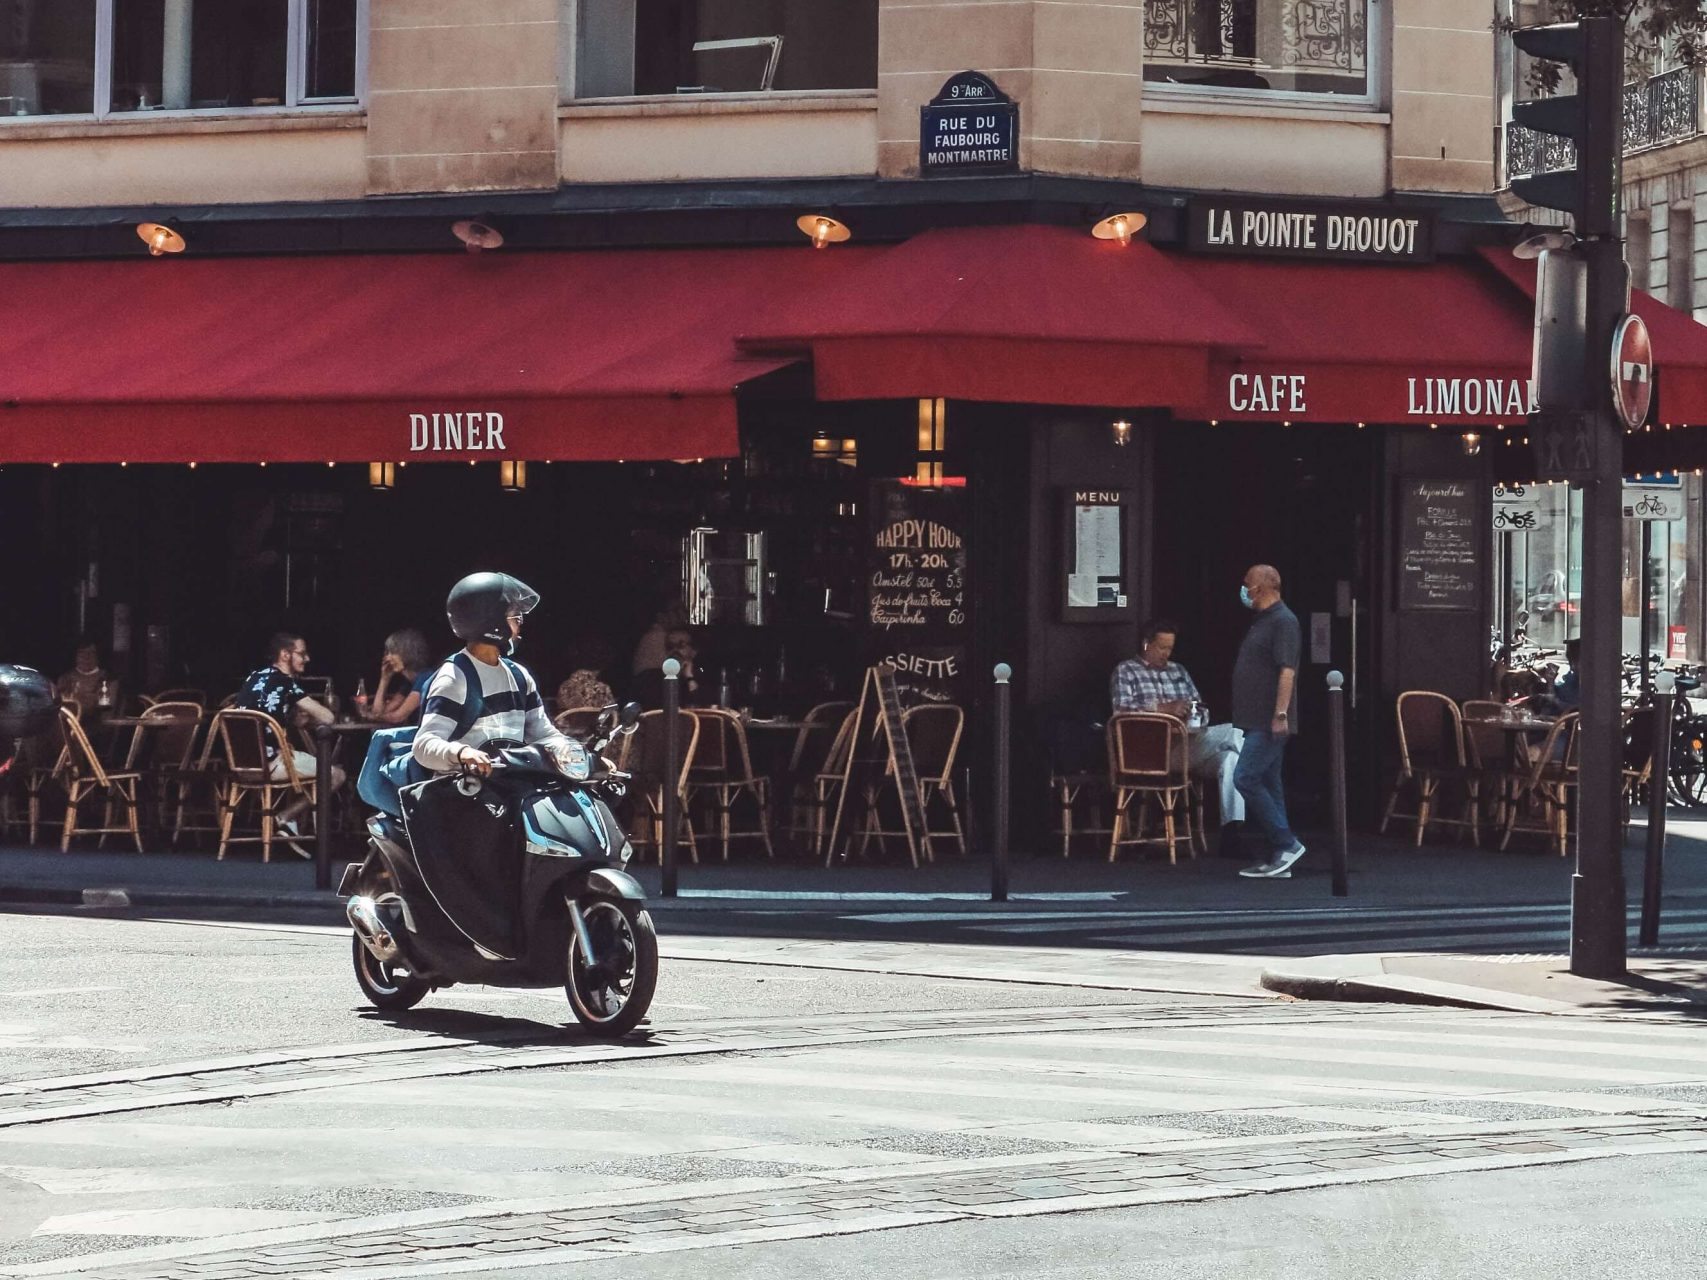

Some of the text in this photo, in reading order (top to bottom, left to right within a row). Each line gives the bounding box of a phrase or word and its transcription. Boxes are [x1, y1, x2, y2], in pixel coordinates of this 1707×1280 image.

[939, 115, 996, 131] RUE DU
[935, 132, 1000, 148] FAUBOURG
[928, 148, 1009, 164] MONTMARTRE
[1207, 208, 1419, 254] LA POINTE DROUOT
[1229, 373, 1306, 412] CAFE
[409, 412, 507, 452] DINER
[1075, 491, 1120, 502] MENU
[876, 519, 962, 549] HAPPY HOUR
[872, 570, 914, 588] Amstel
[954, 591, 964, 606] 4
[879, 653, 958, 679] SSIETTE
